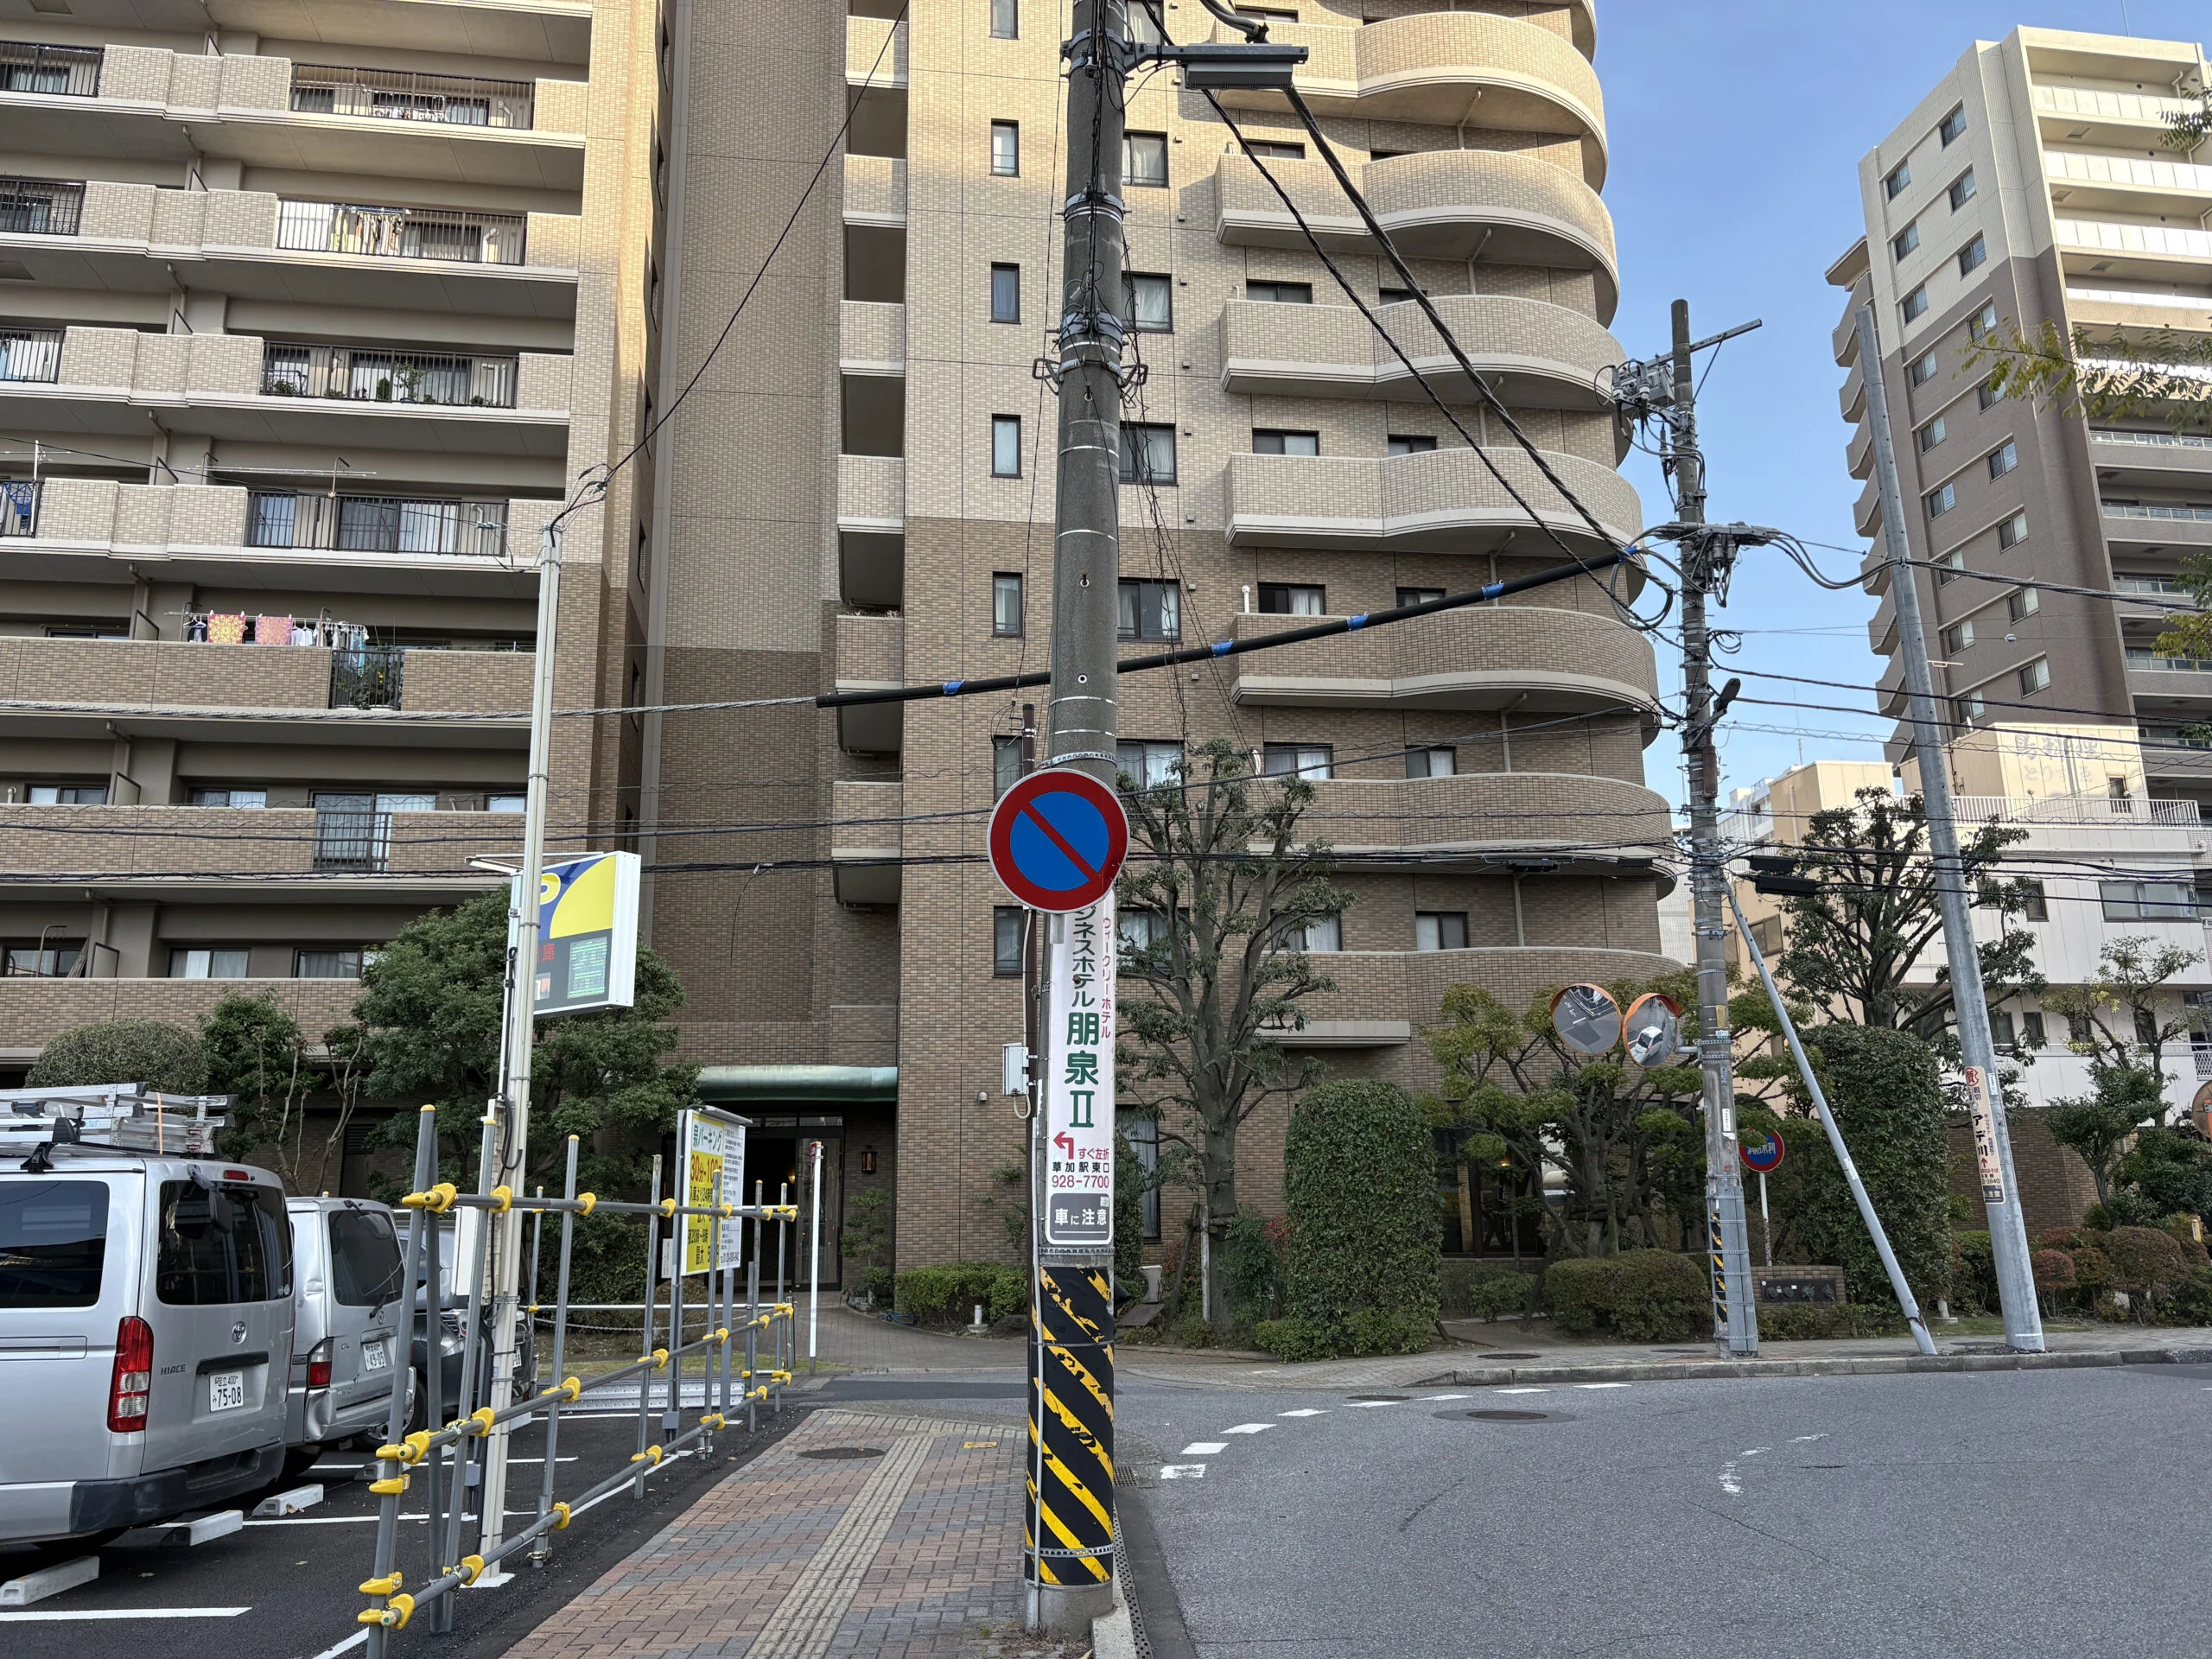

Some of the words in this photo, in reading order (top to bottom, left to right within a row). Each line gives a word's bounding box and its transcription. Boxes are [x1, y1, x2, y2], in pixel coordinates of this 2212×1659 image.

[1101, 916, 1112, 1039] ウィークリーホテル
[1077, 1147, 1109, 1160] すぐ左折
[1052, 1161, 1109, 1173] 草加駅東口
[1052, 1174, 1109, 1189] 928-7700
[1054, 1208, 1107, 1225] 車に注意
[161, 1364, 186, 1376] HIACE
